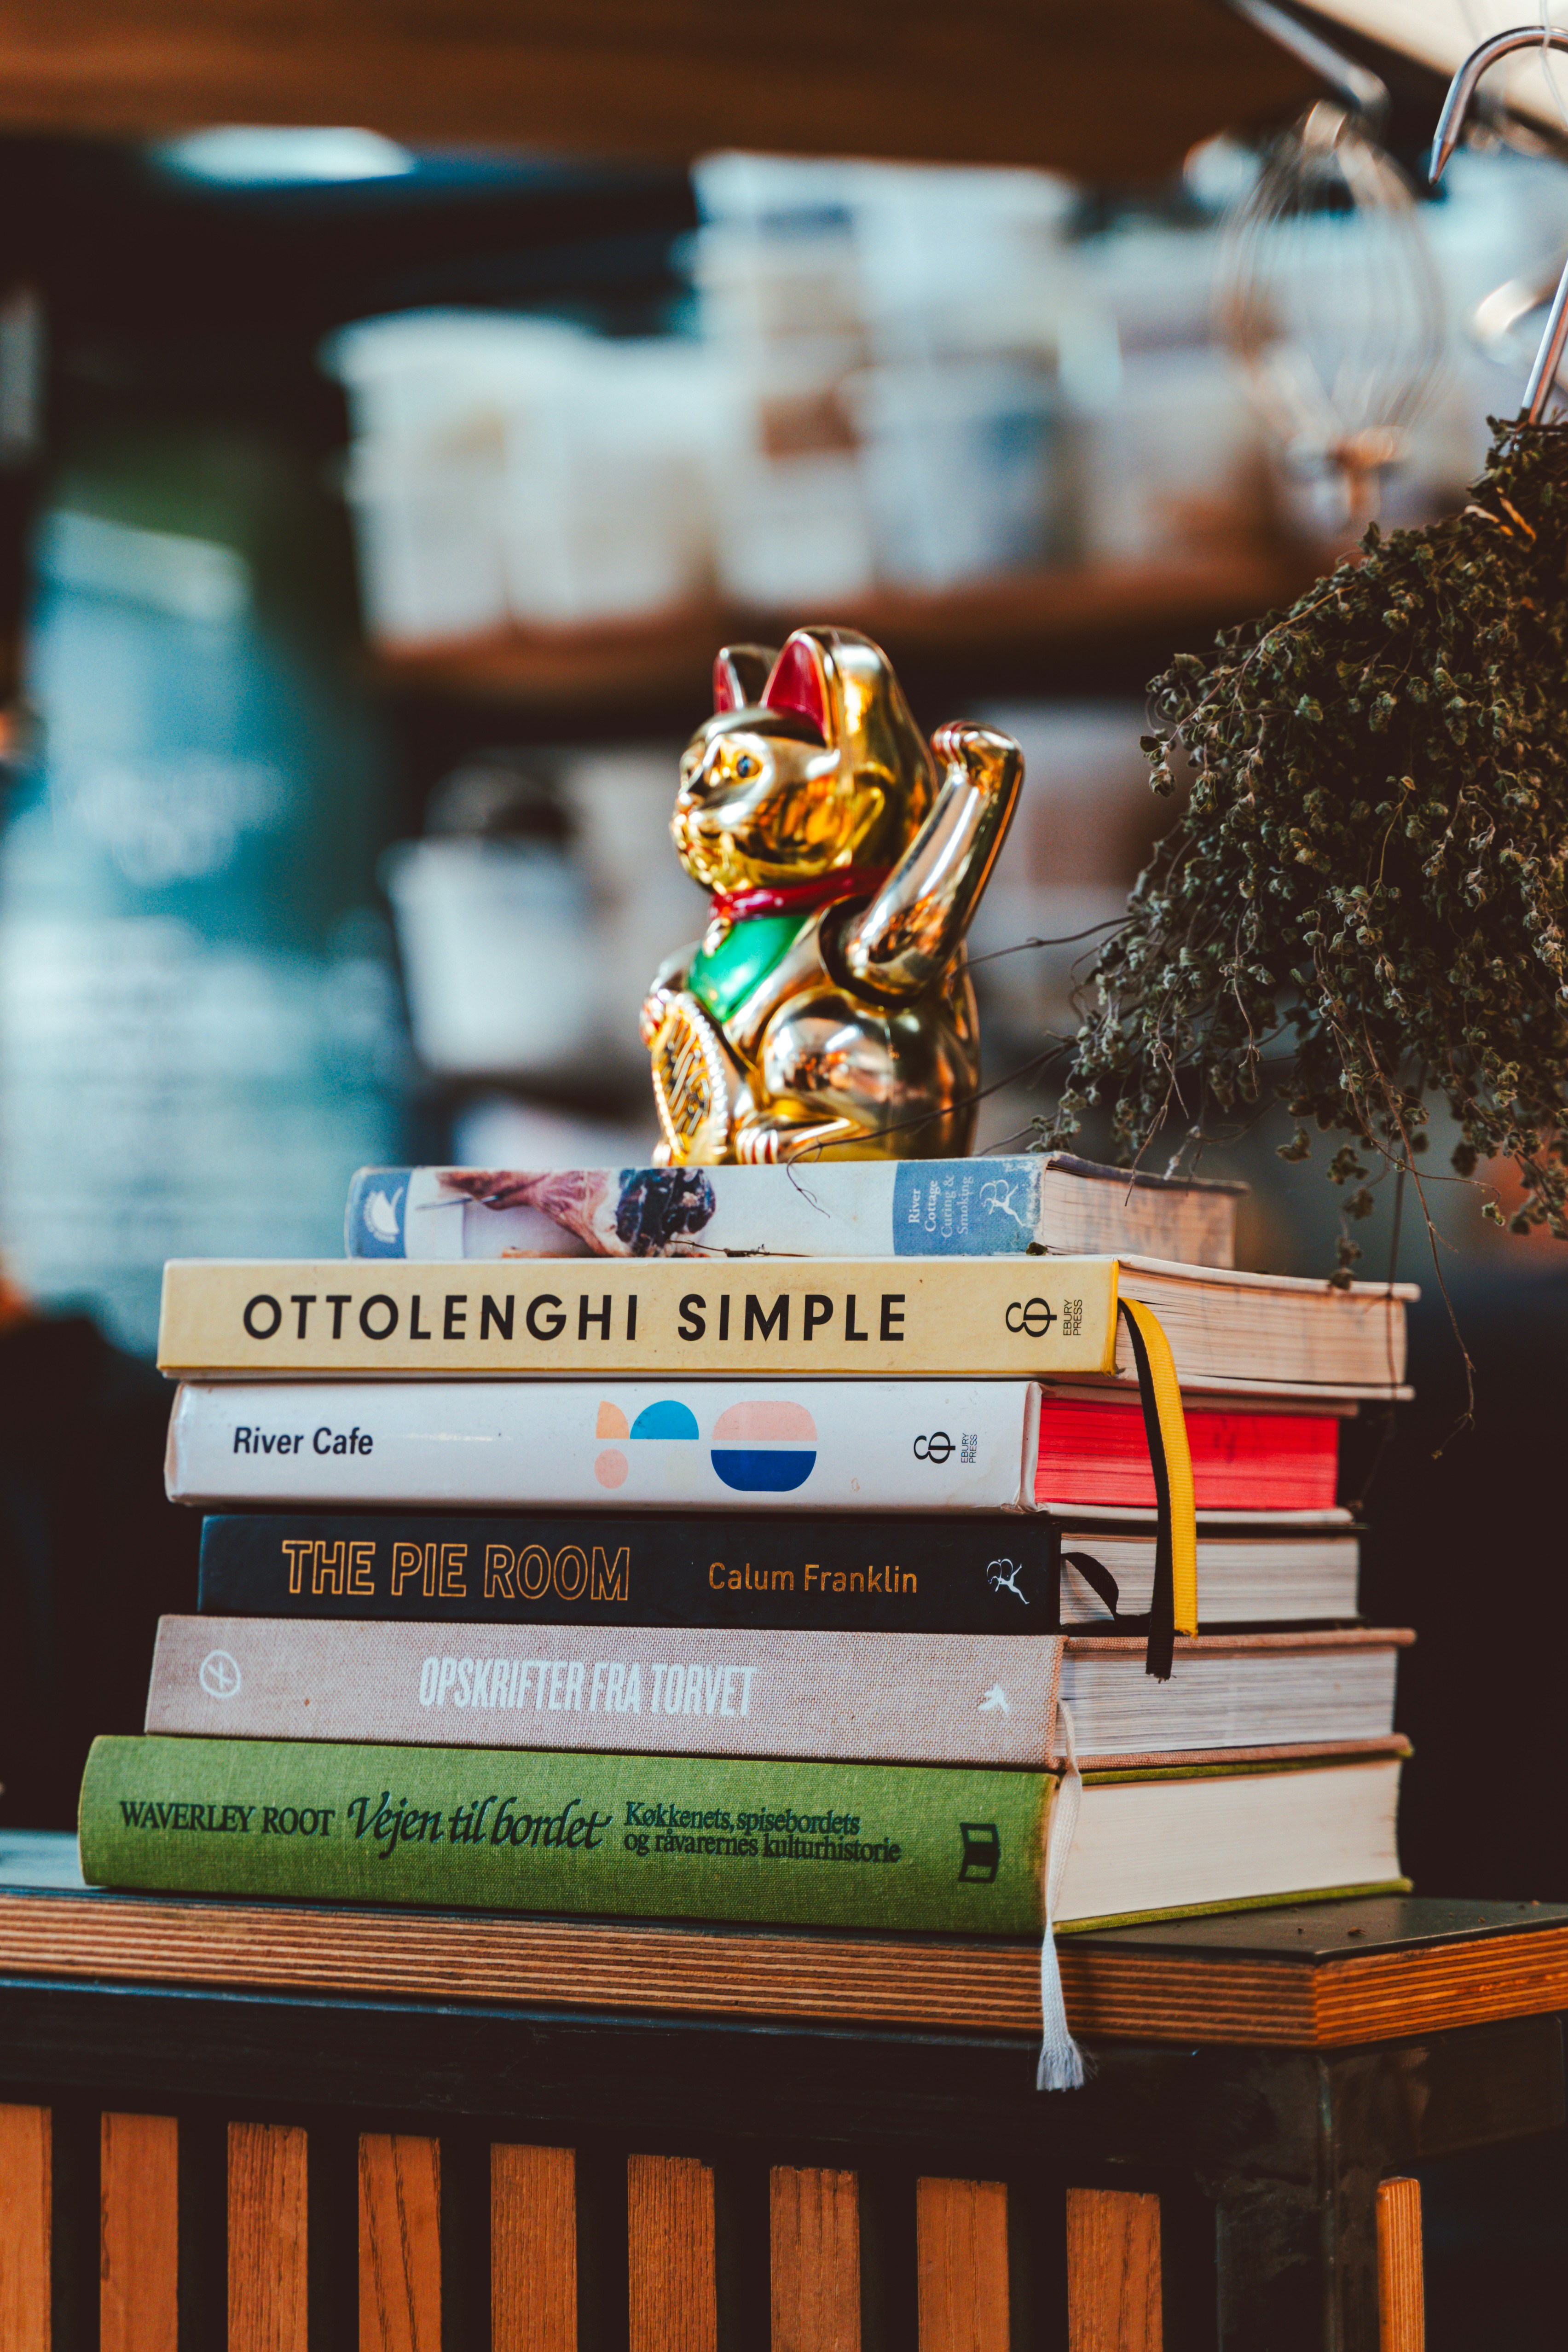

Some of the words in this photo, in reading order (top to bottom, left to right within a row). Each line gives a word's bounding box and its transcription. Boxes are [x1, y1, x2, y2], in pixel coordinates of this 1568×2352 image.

[943, 1174, 955, 1187] &
[908, 1188, 921, 1224] River
[924, 1180, 941, 1232] Cottage
[941, 1190, 956, 1238] Curing
[957, 1176, 974, 1234] Smoking
[243, 1293, 637, 1341] OTTOLENGHI
[677, 1293, 906, 1341] SIMPLE
[1063, 1299, 1072, 1336] EBURY
[1073, 1299, 1082, 1336] PRESS
[233, 1427, 304, 1454] River
[313, 1427, 373, 1455] Cafe
[969, 1434, 978, 1463] PRESS
[282, 1541, 376, 1595] THE
[391, 1542, 468, 1597] PIE
[484, 1544, 630, 1600] ROOM
[709, 1562, 794, 1591] Calum
[804, 1564, 918, 1593] Franklin
[418, 1657, 585, 1711] OPSKRIFTER
[589, 1661, 644, 1714] FRA
[650, 1663, 758, 1717] TORVET
[119, 1801, 256, 1832] WAVERLEY
[261, 1806, 336, 1836] ROOT
[347, 1791, 445, 1860] Vejen
[448, 1796, 498, 1844] til
[490, 1796, 613, 1849] bordet
[624, 1801, 735, 1833] Køkkenets,
[736, 1807, 861, 1836] spisebordets
[624, 1833, 650, 1857] og
[654, 1828, 758, 1857] råvarernes
[763, 1833, 902, 1863] kulturhistorie
